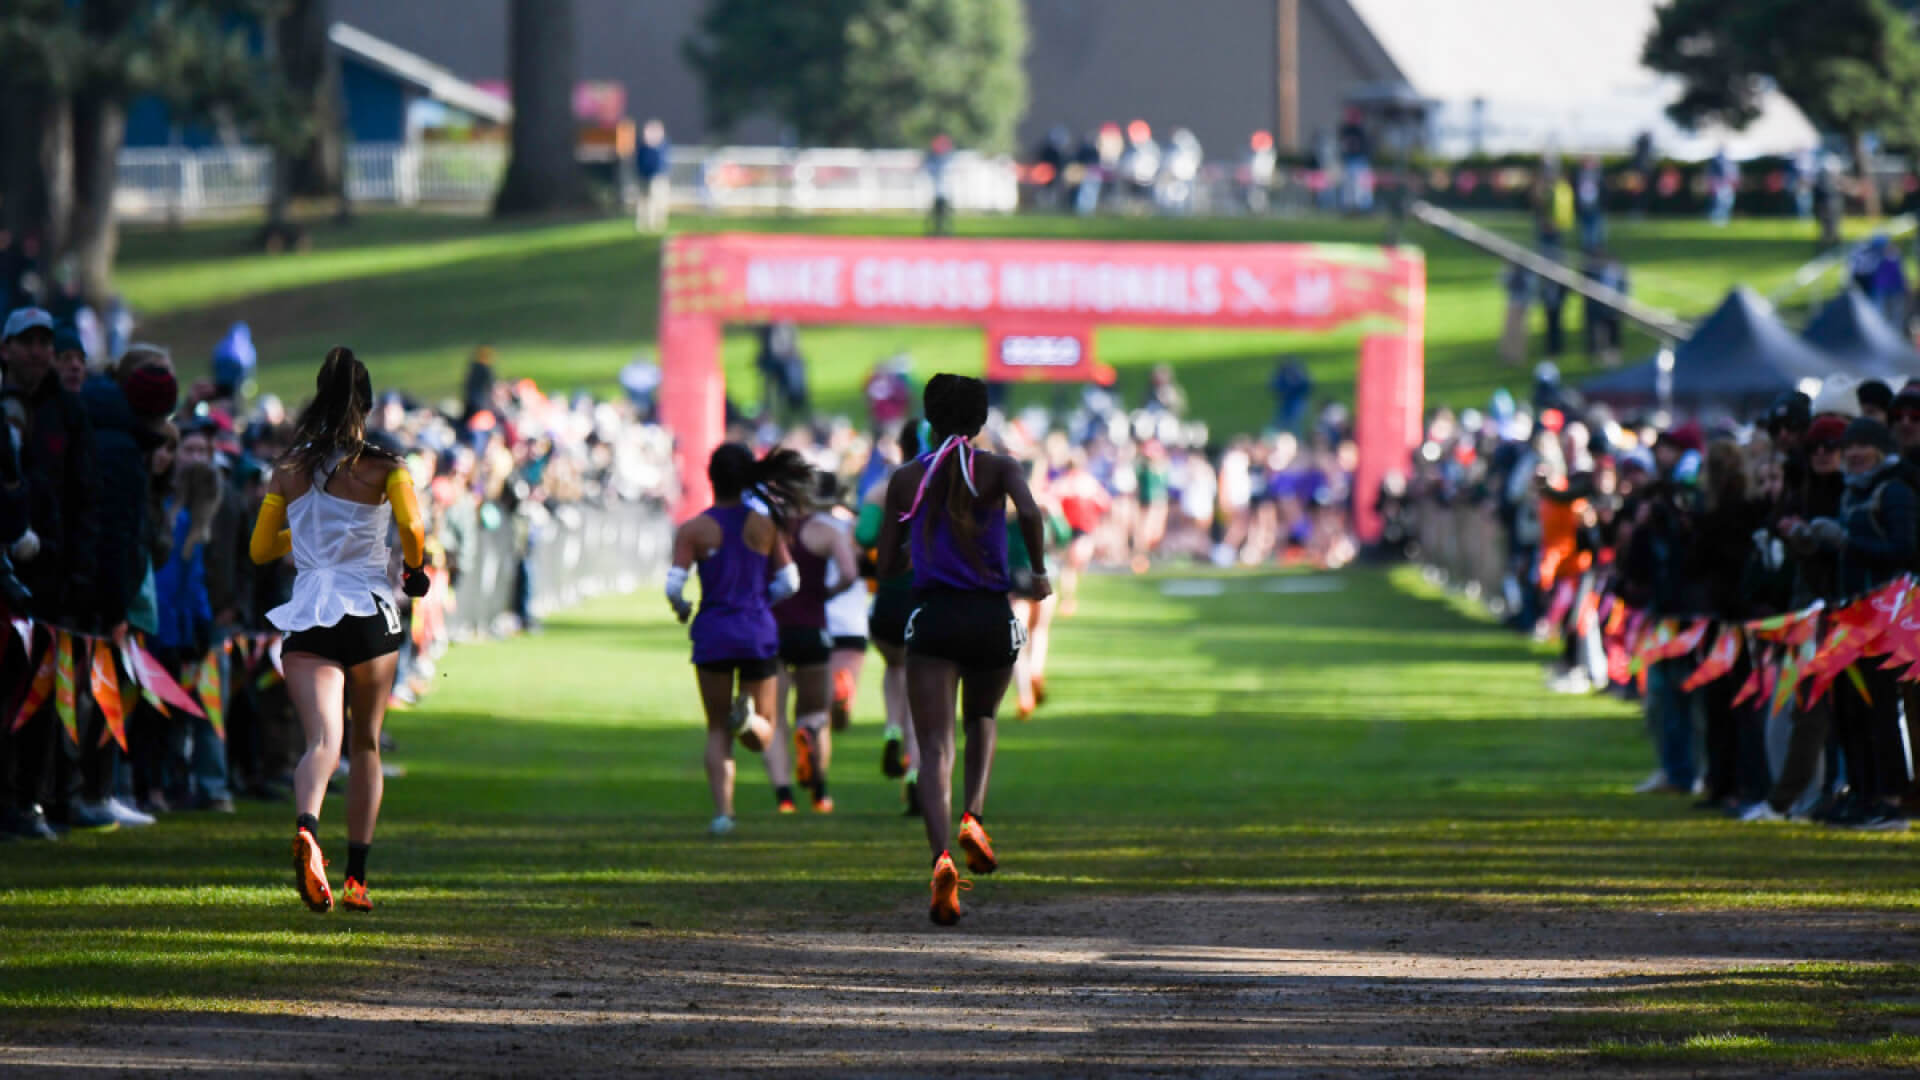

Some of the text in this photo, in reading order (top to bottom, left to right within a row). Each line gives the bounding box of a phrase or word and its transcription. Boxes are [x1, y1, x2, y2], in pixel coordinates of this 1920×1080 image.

[747, 257, 1222, 314] NIKE CROSS NATIONALS
